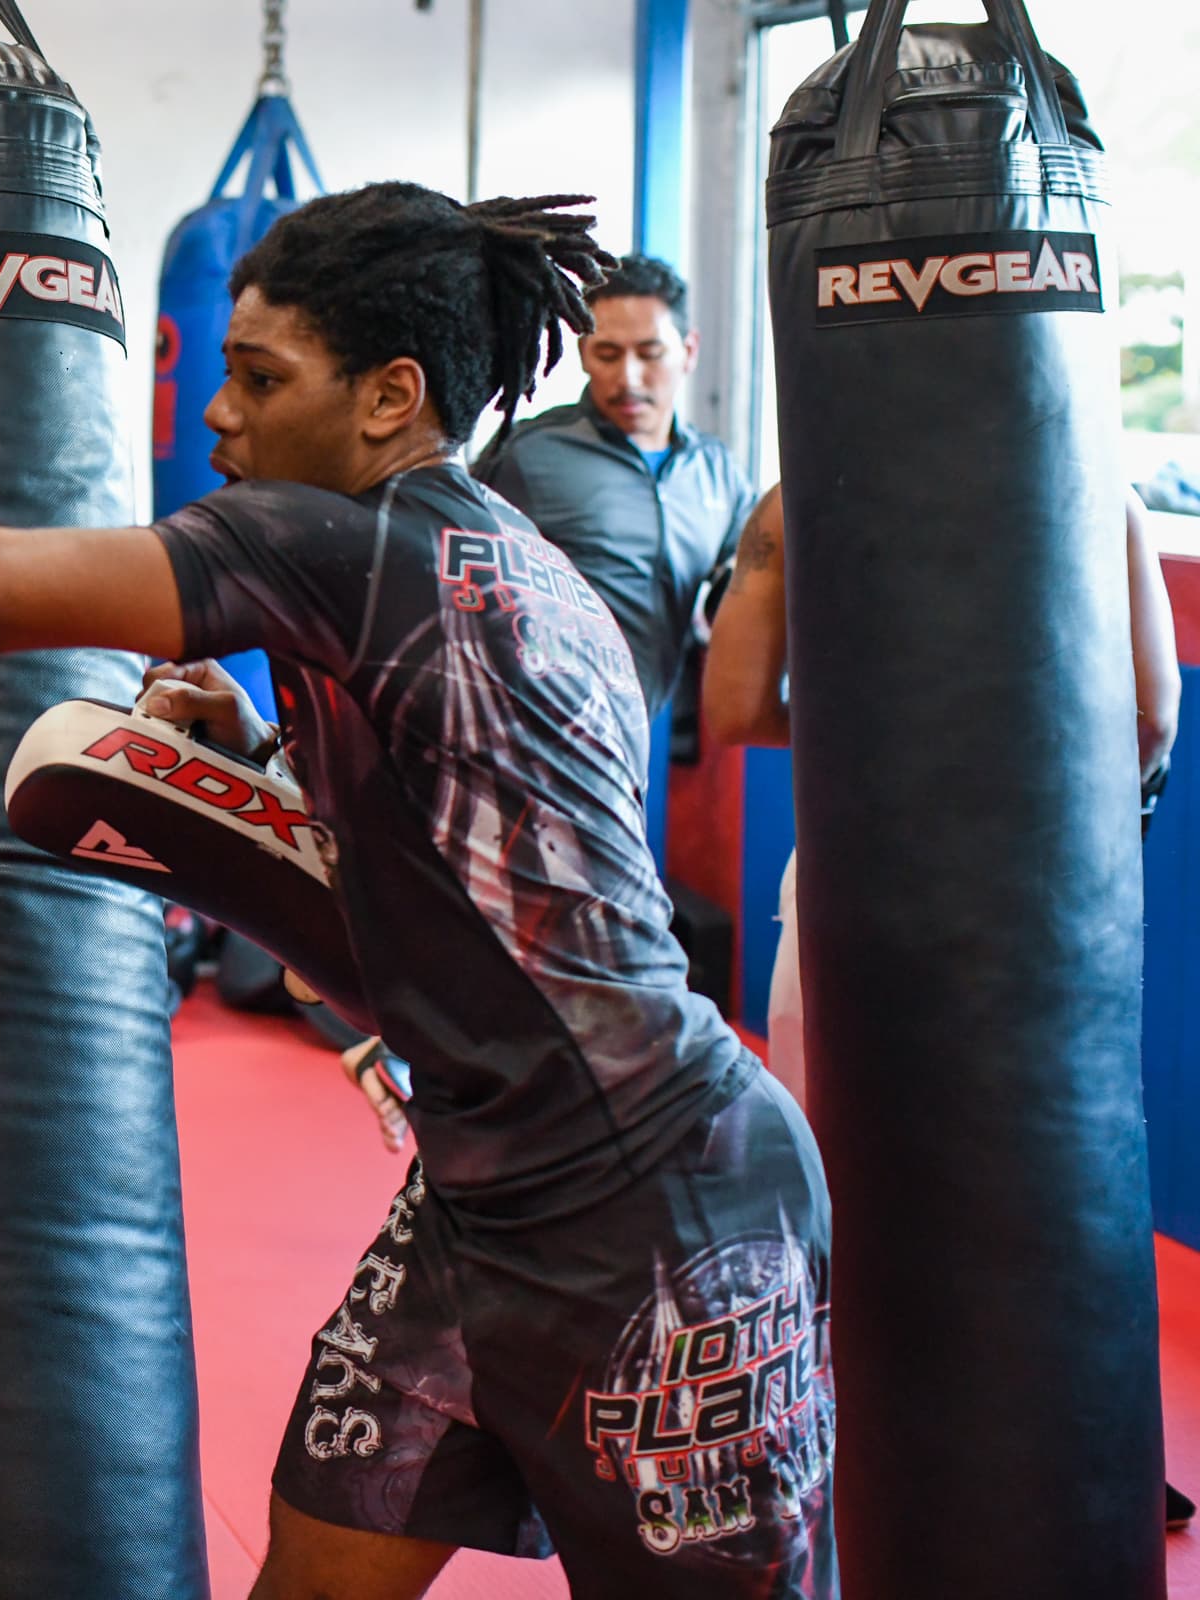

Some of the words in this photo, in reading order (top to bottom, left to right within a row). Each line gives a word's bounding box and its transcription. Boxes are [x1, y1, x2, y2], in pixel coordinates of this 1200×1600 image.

[817, 237, 1099, 313] REVGEAR
[81, 726, 309, 852] RDX
[637, 1476, 755, 1556] SAN
